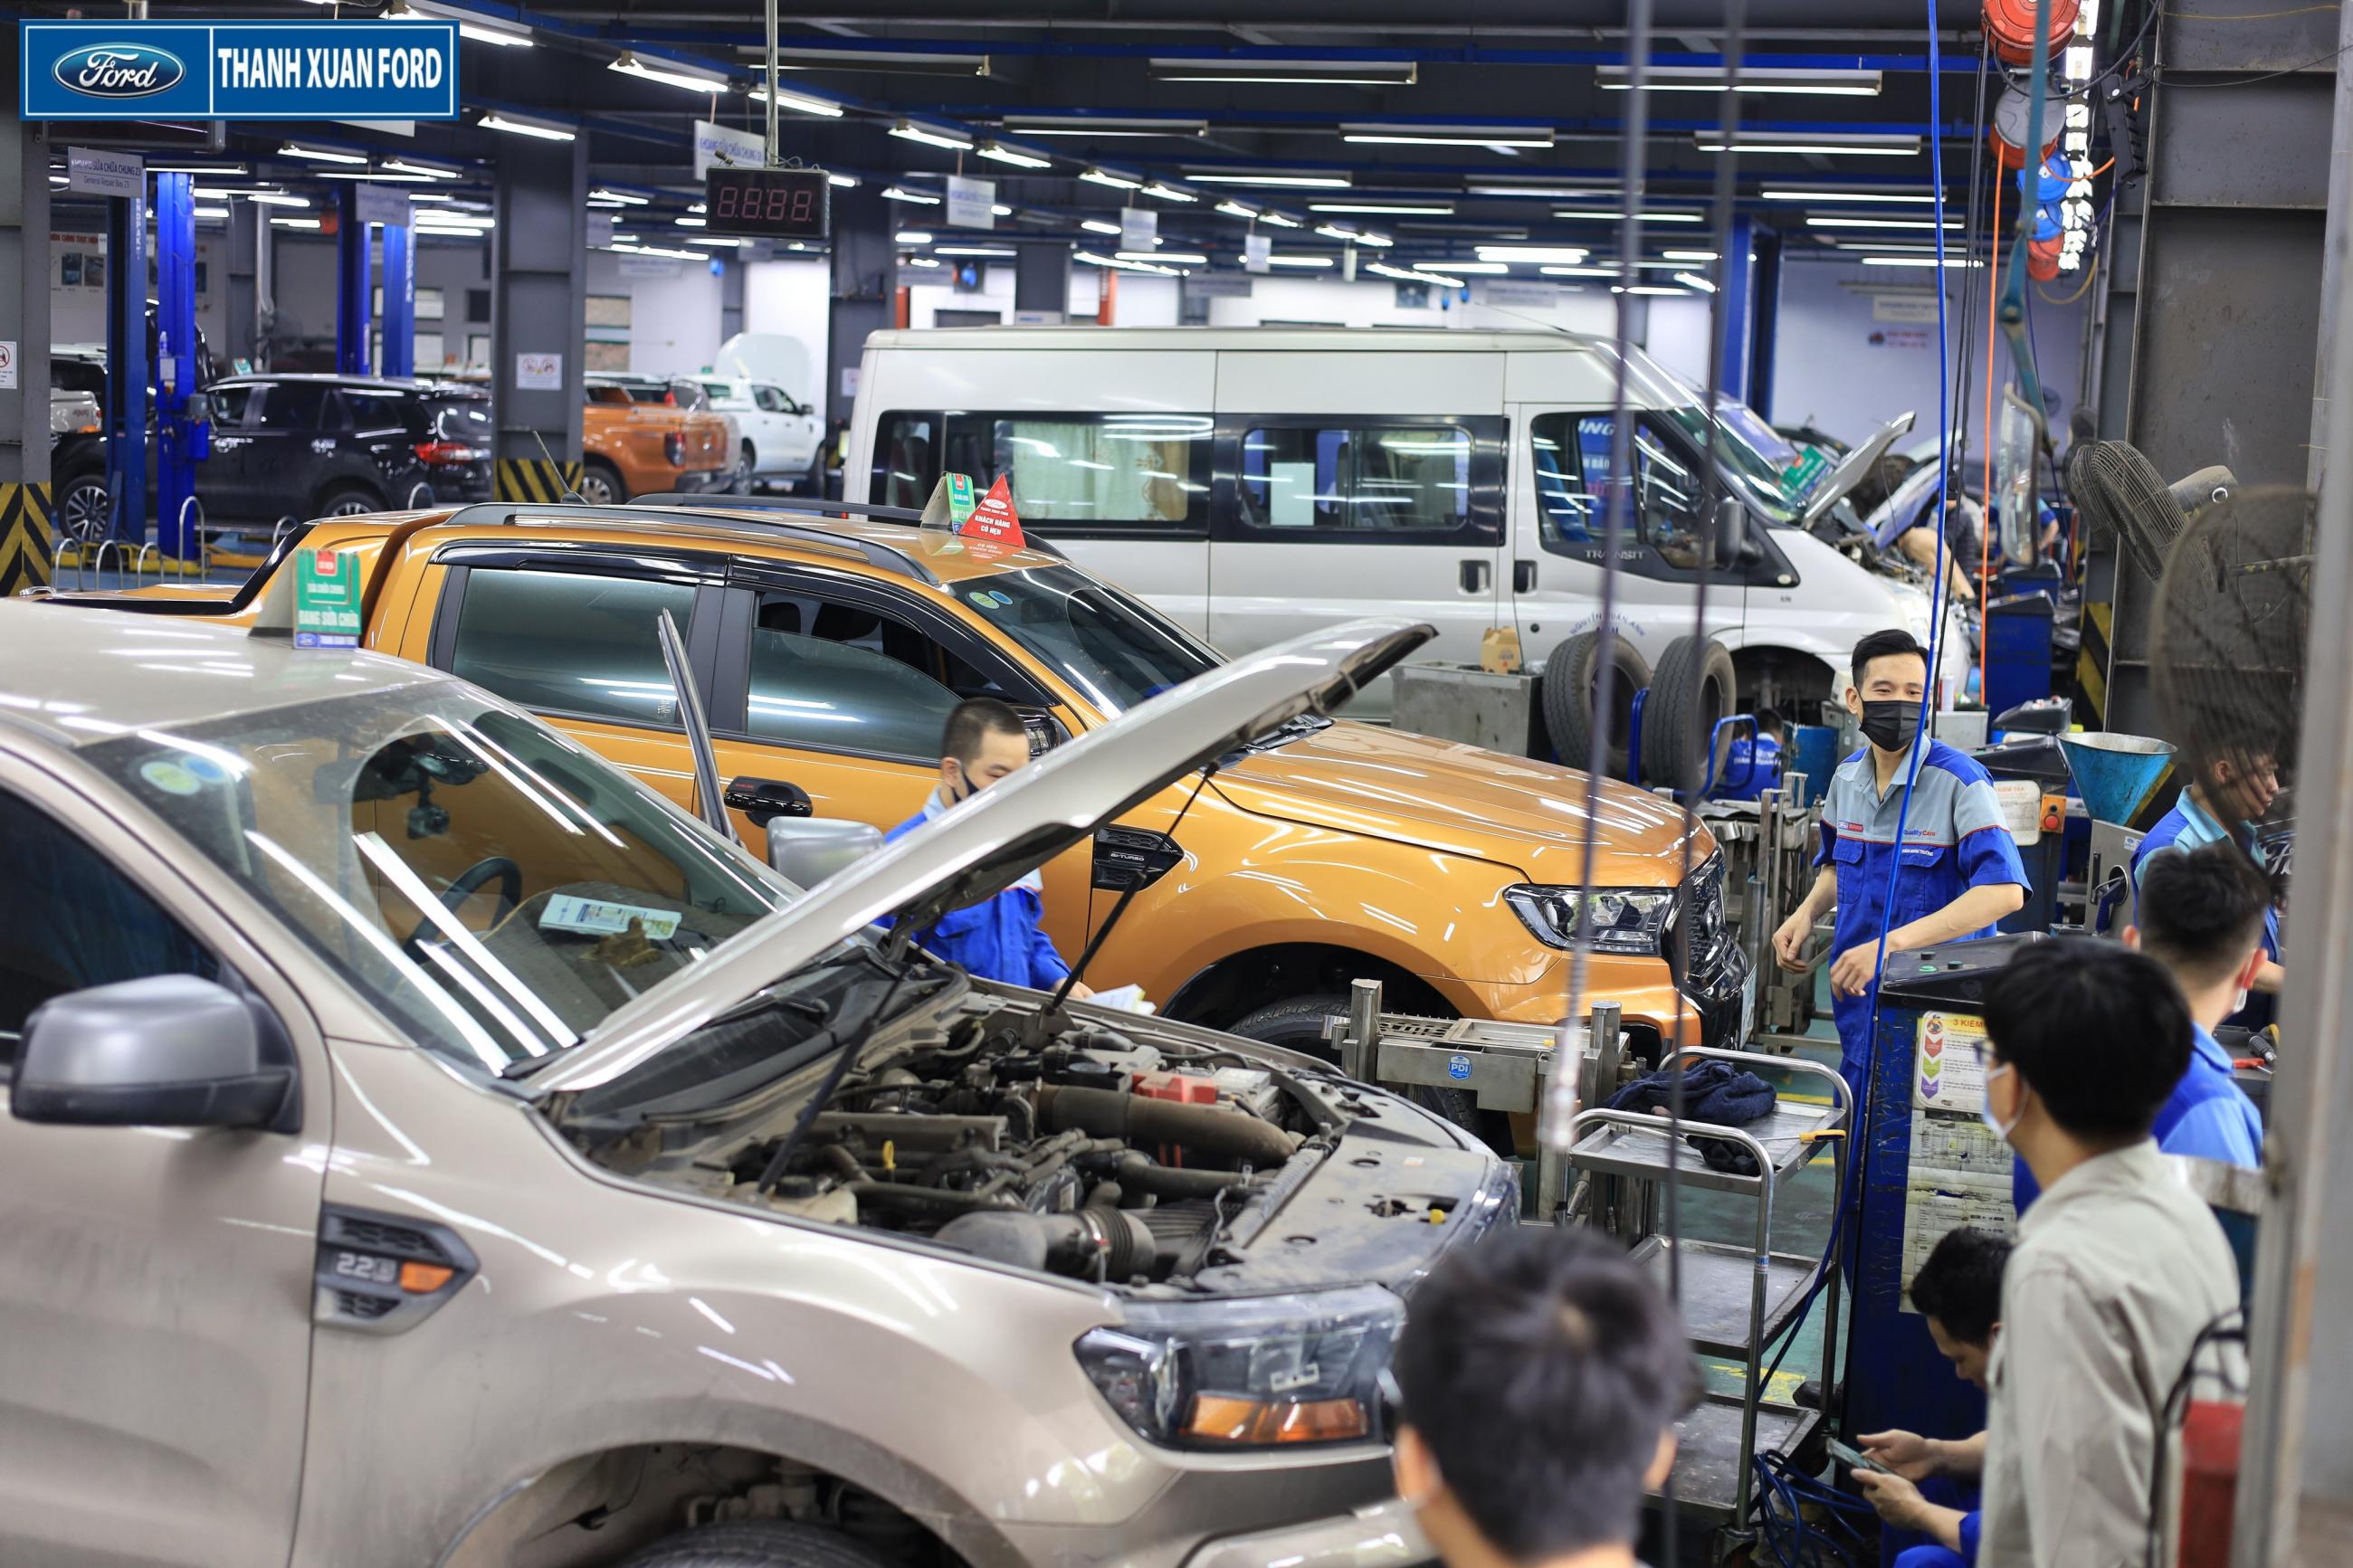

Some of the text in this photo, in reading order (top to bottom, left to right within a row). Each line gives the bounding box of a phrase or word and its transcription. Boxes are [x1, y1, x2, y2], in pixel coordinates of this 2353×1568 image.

[975, 514, 994, 526] KHÁCH
[995, 518, 1011, 529] HÀNG
[980, 524, 1002, 537] CÓ HẸN
[1586, 549, 1643, 560] TRNSIT
[1451, 1063, 1469, 1073] PDI
